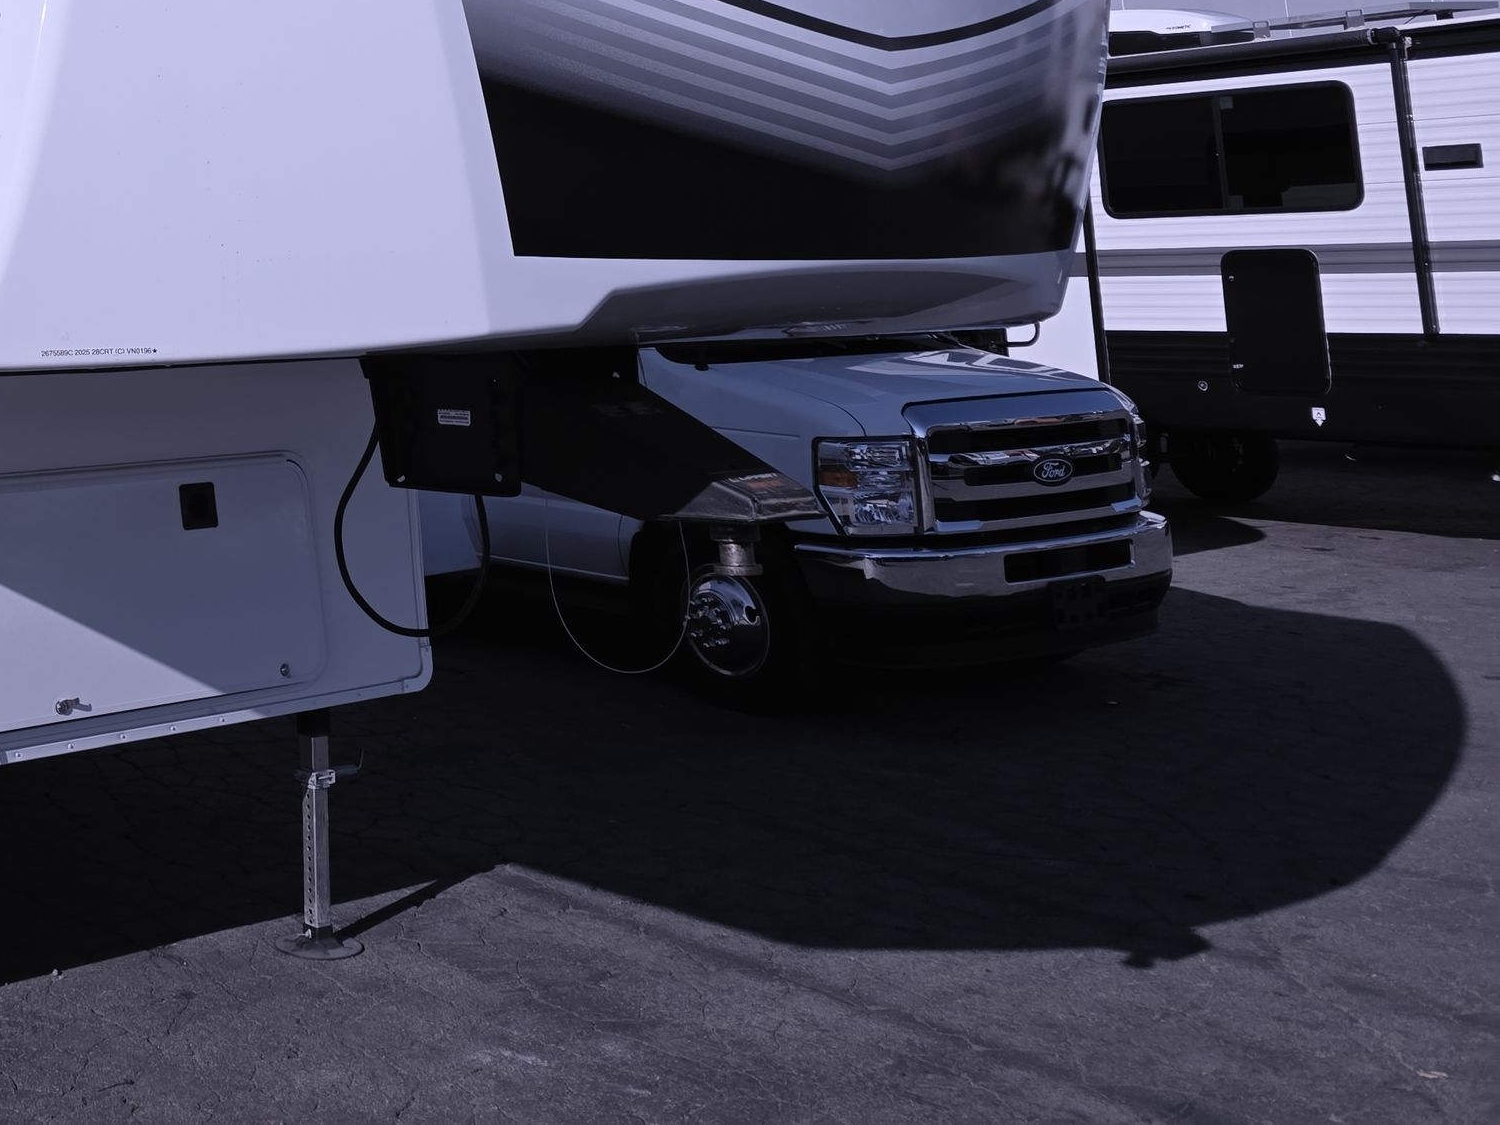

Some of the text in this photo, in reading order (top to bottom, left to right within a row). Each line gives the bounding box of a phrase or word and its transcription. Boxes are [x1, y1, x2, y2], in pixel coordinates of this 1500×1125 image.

[74, 348, 91, 356] 2025
[114, 347, 125, 355] (C)
[1041, 462, 1066, 479] Ford
